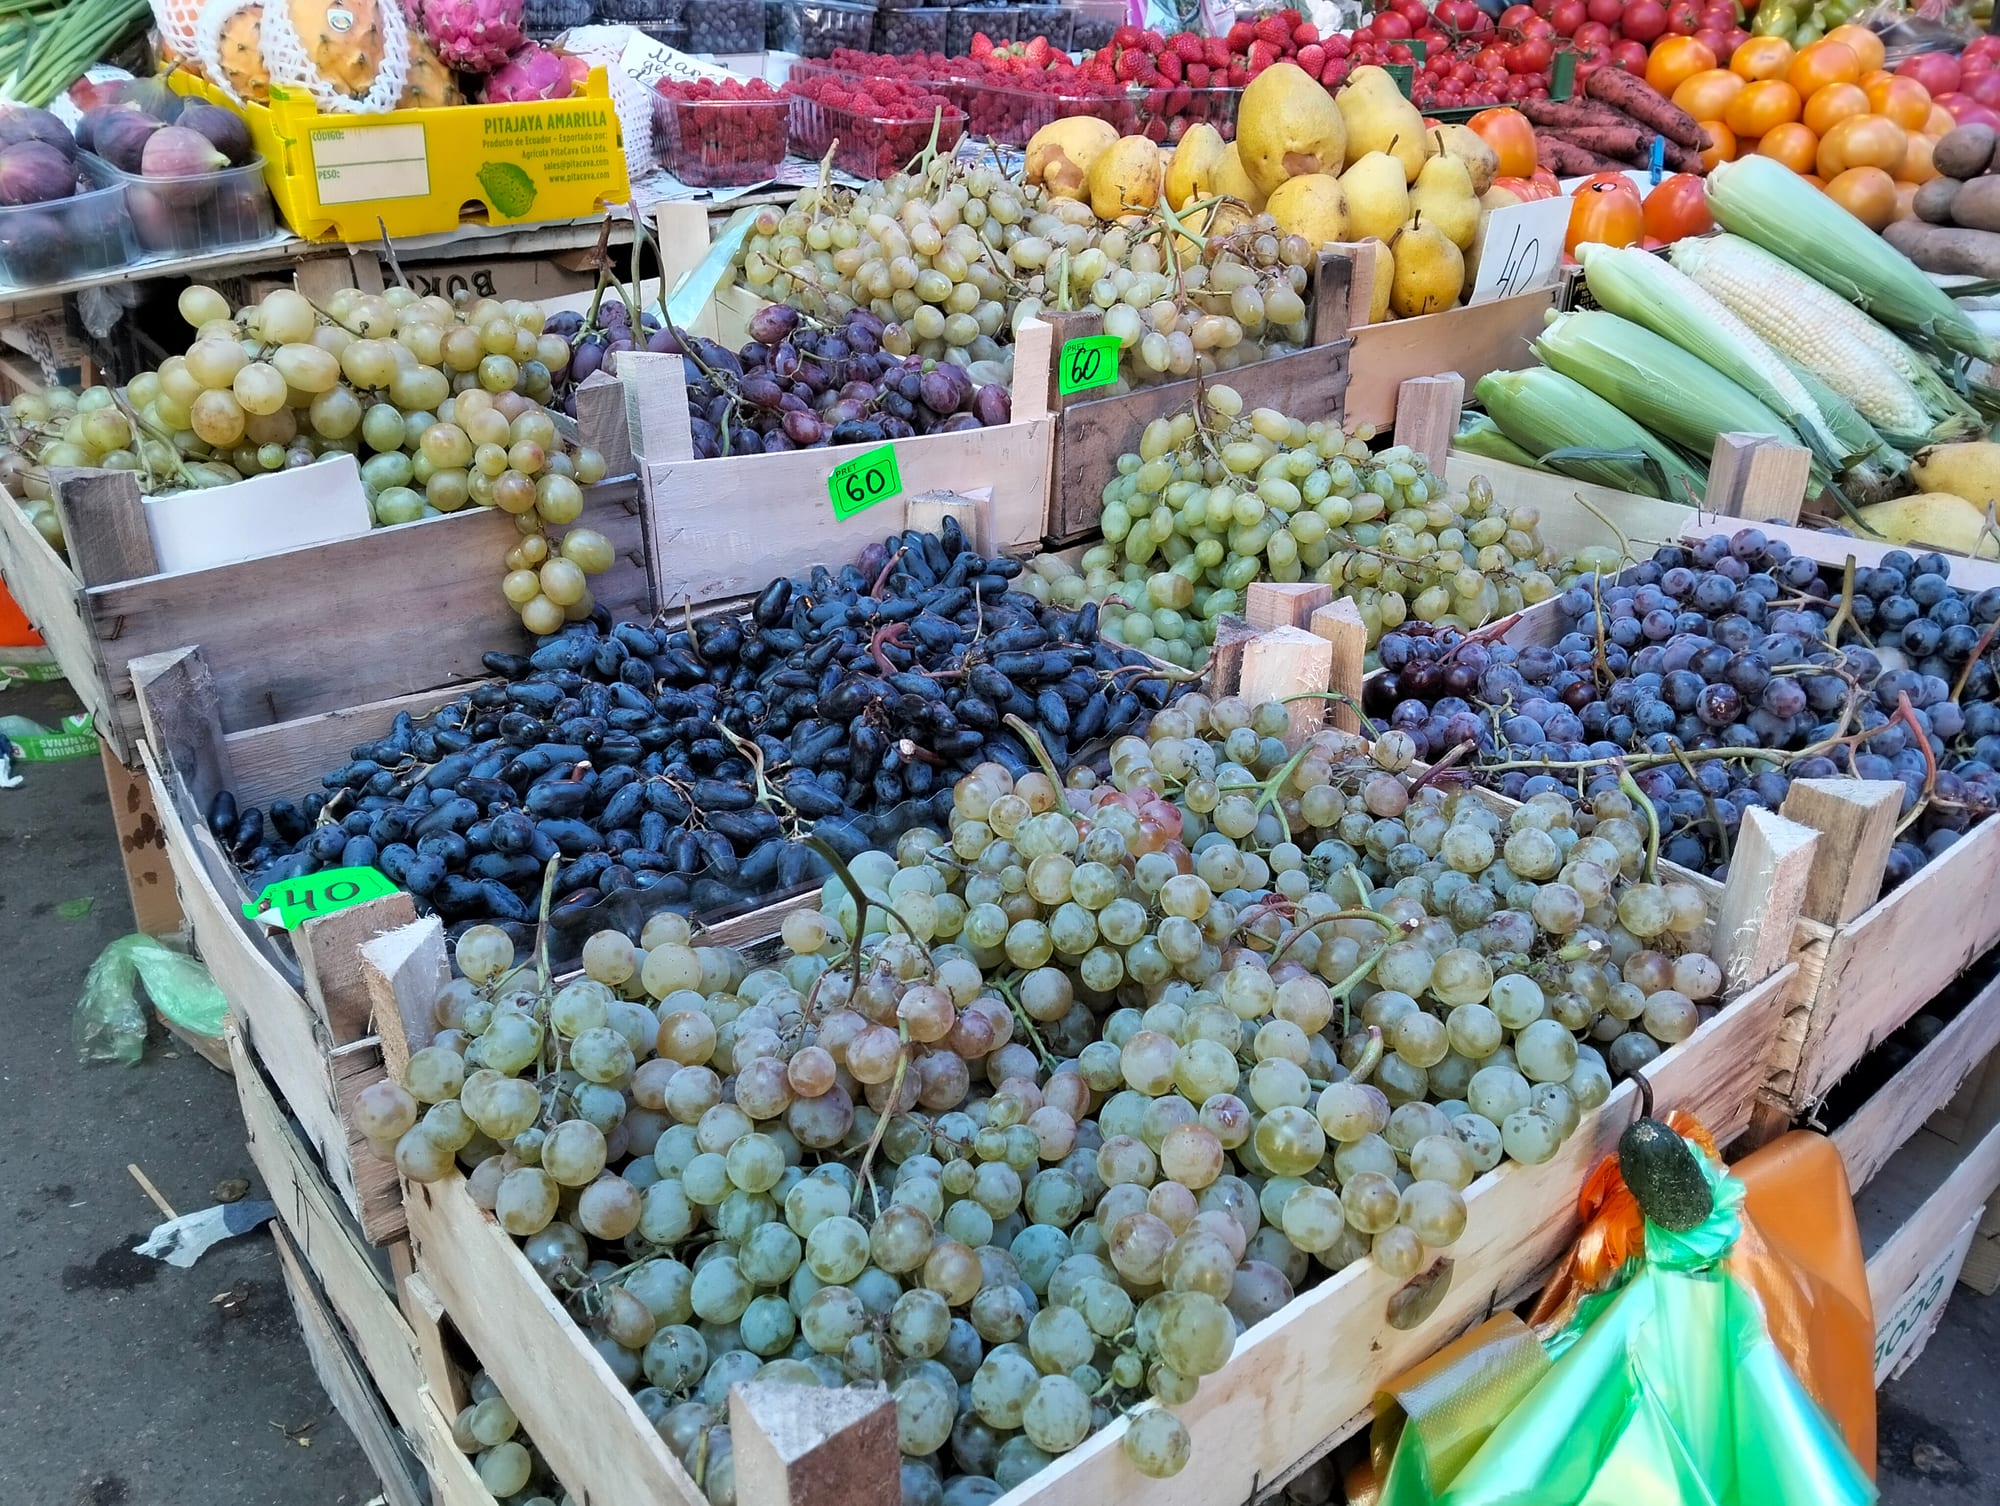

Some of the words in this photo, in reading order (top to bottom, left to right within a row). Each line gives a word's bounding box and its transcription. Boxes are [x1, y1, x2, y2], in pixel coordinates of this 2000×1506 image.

[484, 114, 543, 134] PITAJAYA
[547, 110, 607, 130] AMARILLA
[482, 138, 514, 149] Producto
[515, 137, 524, 146] de
[525, 134, 552, 146] Ecuador
[559, 131, 592, 144] Exportado
[594, 131, 608, 142] por:
[551, 145, 579, 157] PitaCava
[544, 158, 610, 172] sales@pitacava.com
[318, 169, 341, 180] PESO:
[549, 170, 611, 184] www.pitacava.com
[1496, 224, 1539, 299] 40
[1072, 347, 1101, 384] 60
[846, 468, 886, 502] 60
[42, 742, 98, 757] PREMIUM
[286, 881, 361, 911] 40
